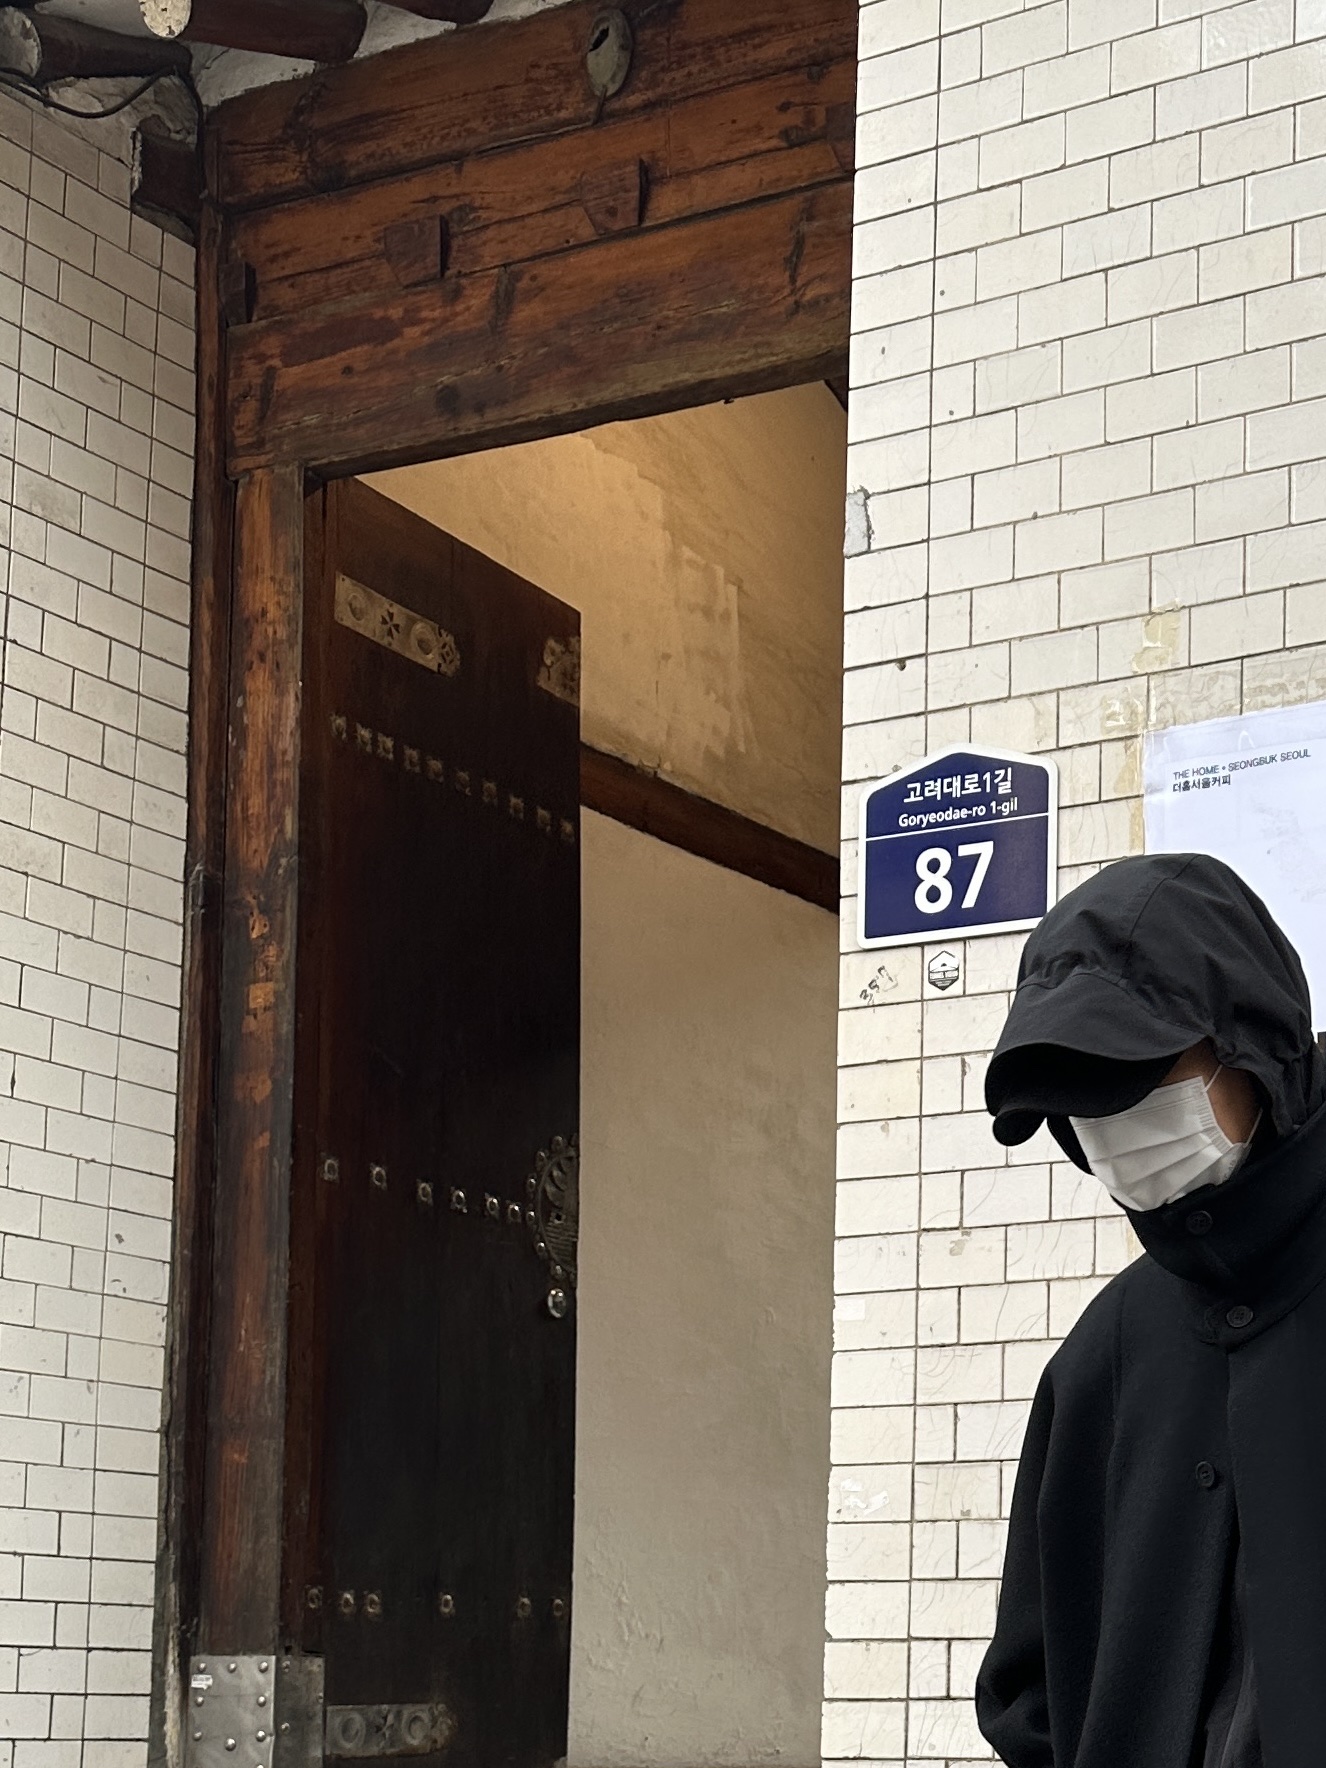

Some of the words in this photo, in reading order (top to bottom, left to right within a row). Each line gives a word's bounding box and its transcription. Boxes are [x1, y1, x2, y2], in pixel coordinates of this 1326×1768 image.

[1173, 769, 1190, 780] THE
[1191, 765, 1220, 777] HOME
[1228, 754, 1278, 772] SEONGBUK
[1279, 749, 1311, 762] SEOUL
[903, 767, 1012, 803] 고려대로1길
[1172, 774, 1231, 793] 더홈서울커피
[898, 806, 986, 828] Goryeodae-ro
[989, 797, 1018, 816] 1-gil
[914, 841, 995, 914] 87
